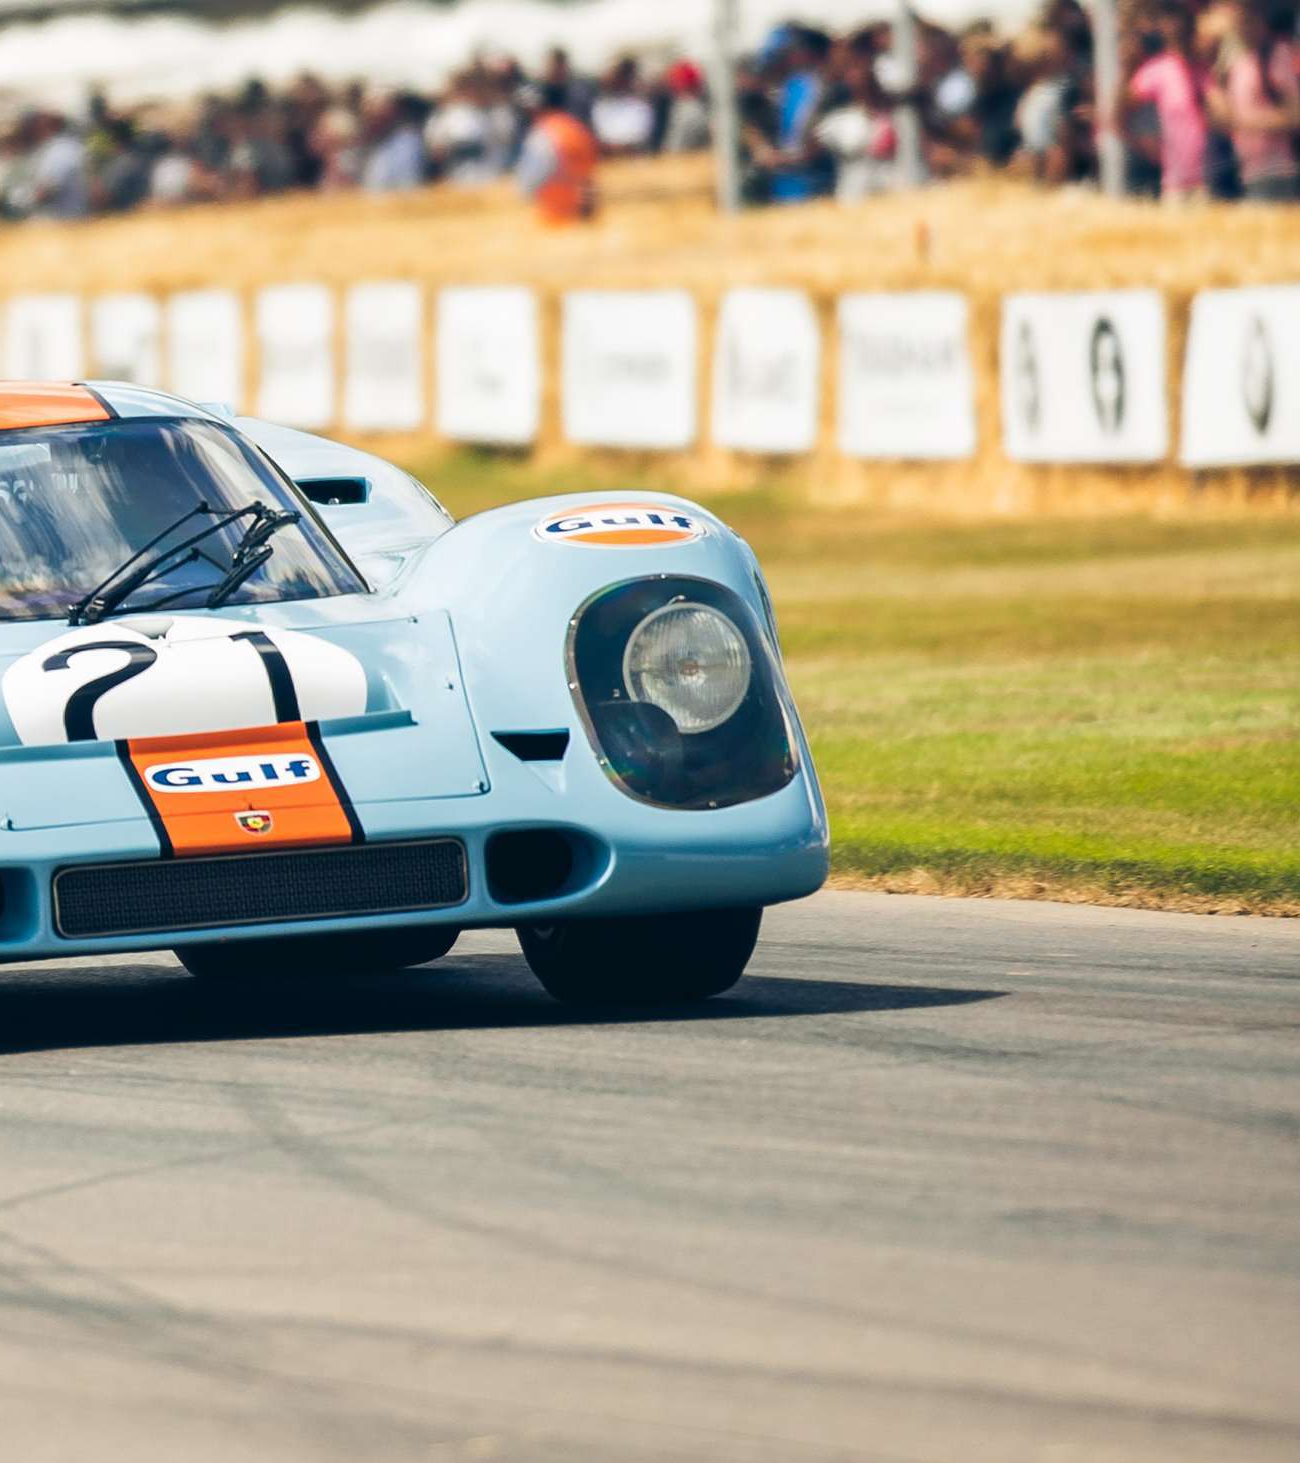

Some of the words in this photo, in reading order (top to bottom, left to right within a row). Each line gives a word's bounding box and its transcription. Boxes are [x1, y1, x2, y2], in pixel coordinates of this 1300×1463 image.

[546, 513, 692, 533] Gulf
[41, 631, 302, 742] 21
[151, 759, 310, 787] Gulf
